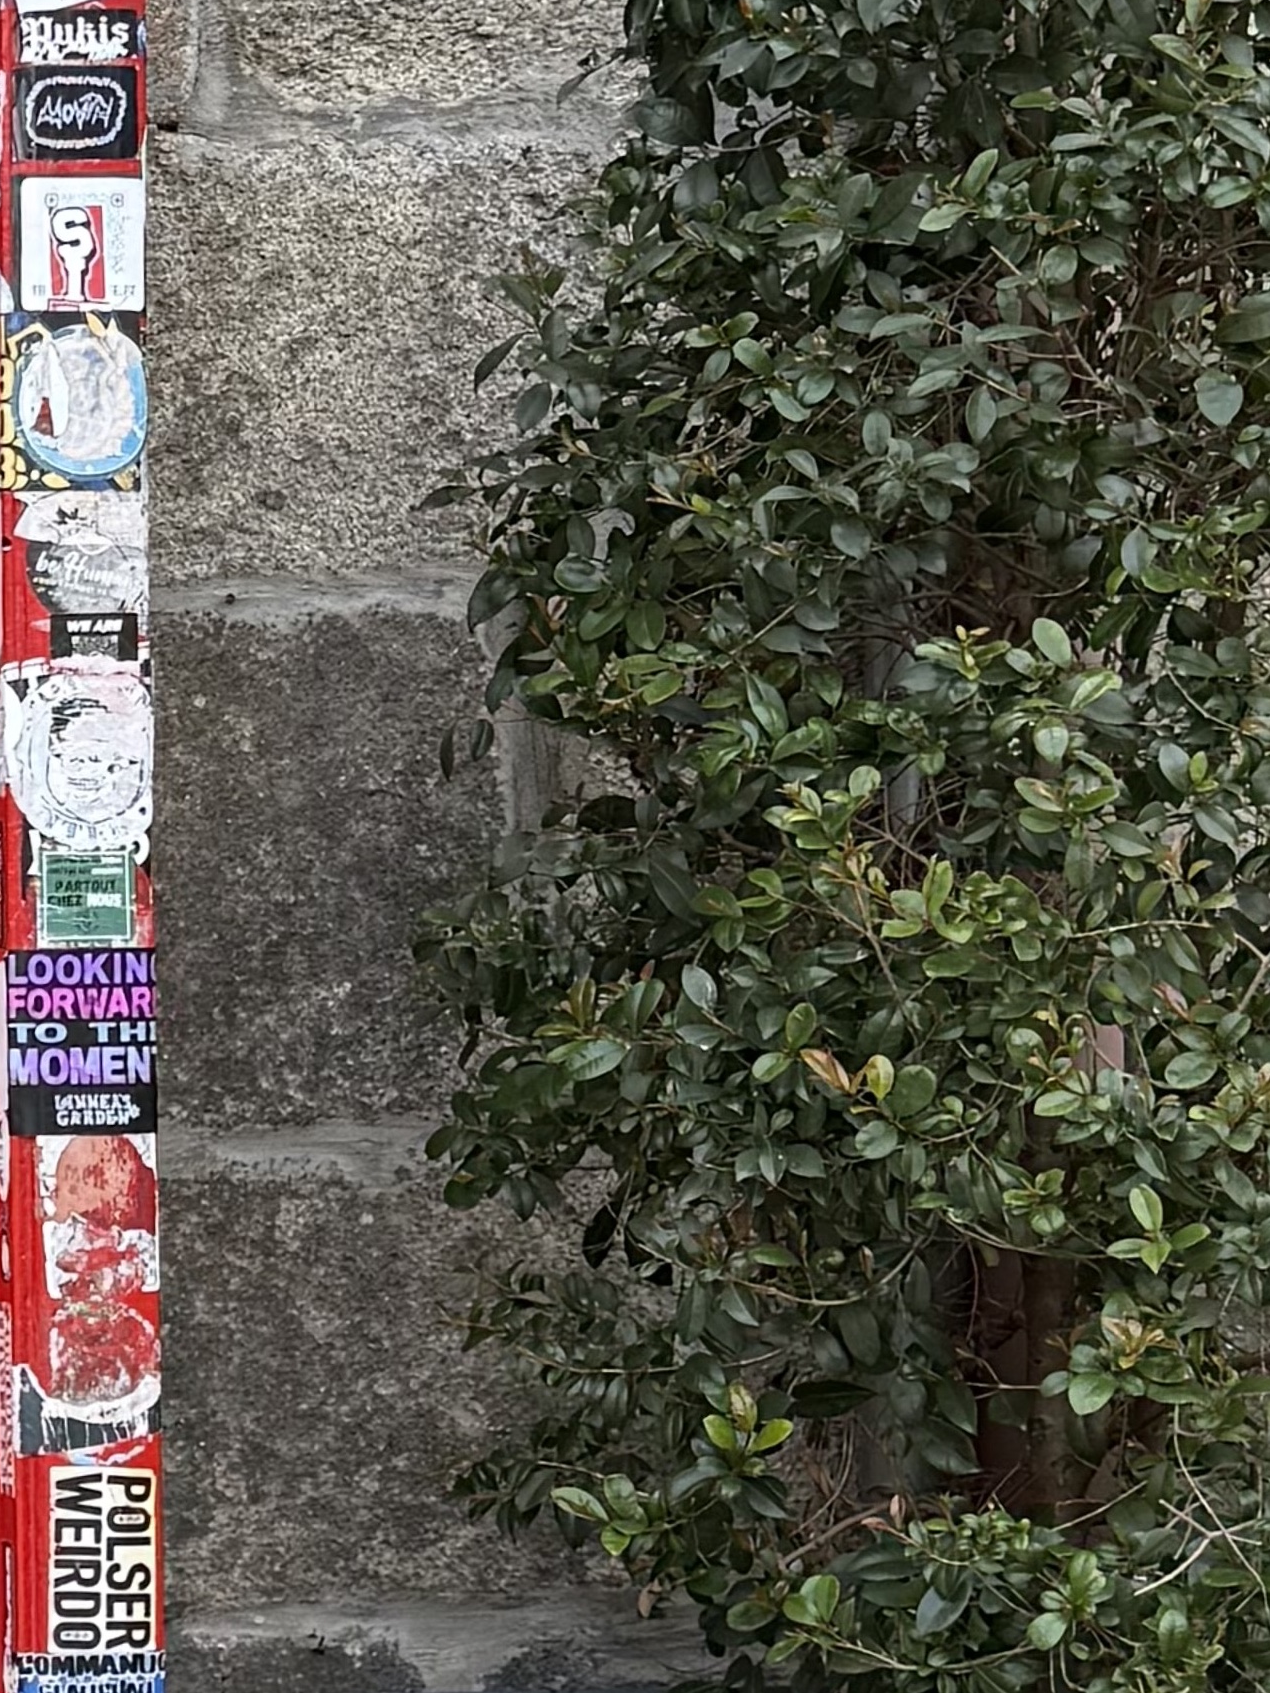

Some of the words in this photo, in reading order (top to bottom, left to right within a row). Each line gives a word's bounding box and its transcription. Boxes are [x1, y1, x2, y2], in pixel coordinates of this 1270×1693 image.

[7, 988, 157, 1020] FORWAR
[7, 1023, 68, 1044] TO
[7, 1047, 157, 1086] MOMEN
[52, 1472, 103, 1651] WEIRDO
[105, 1476, 152, 1651] POLSER
